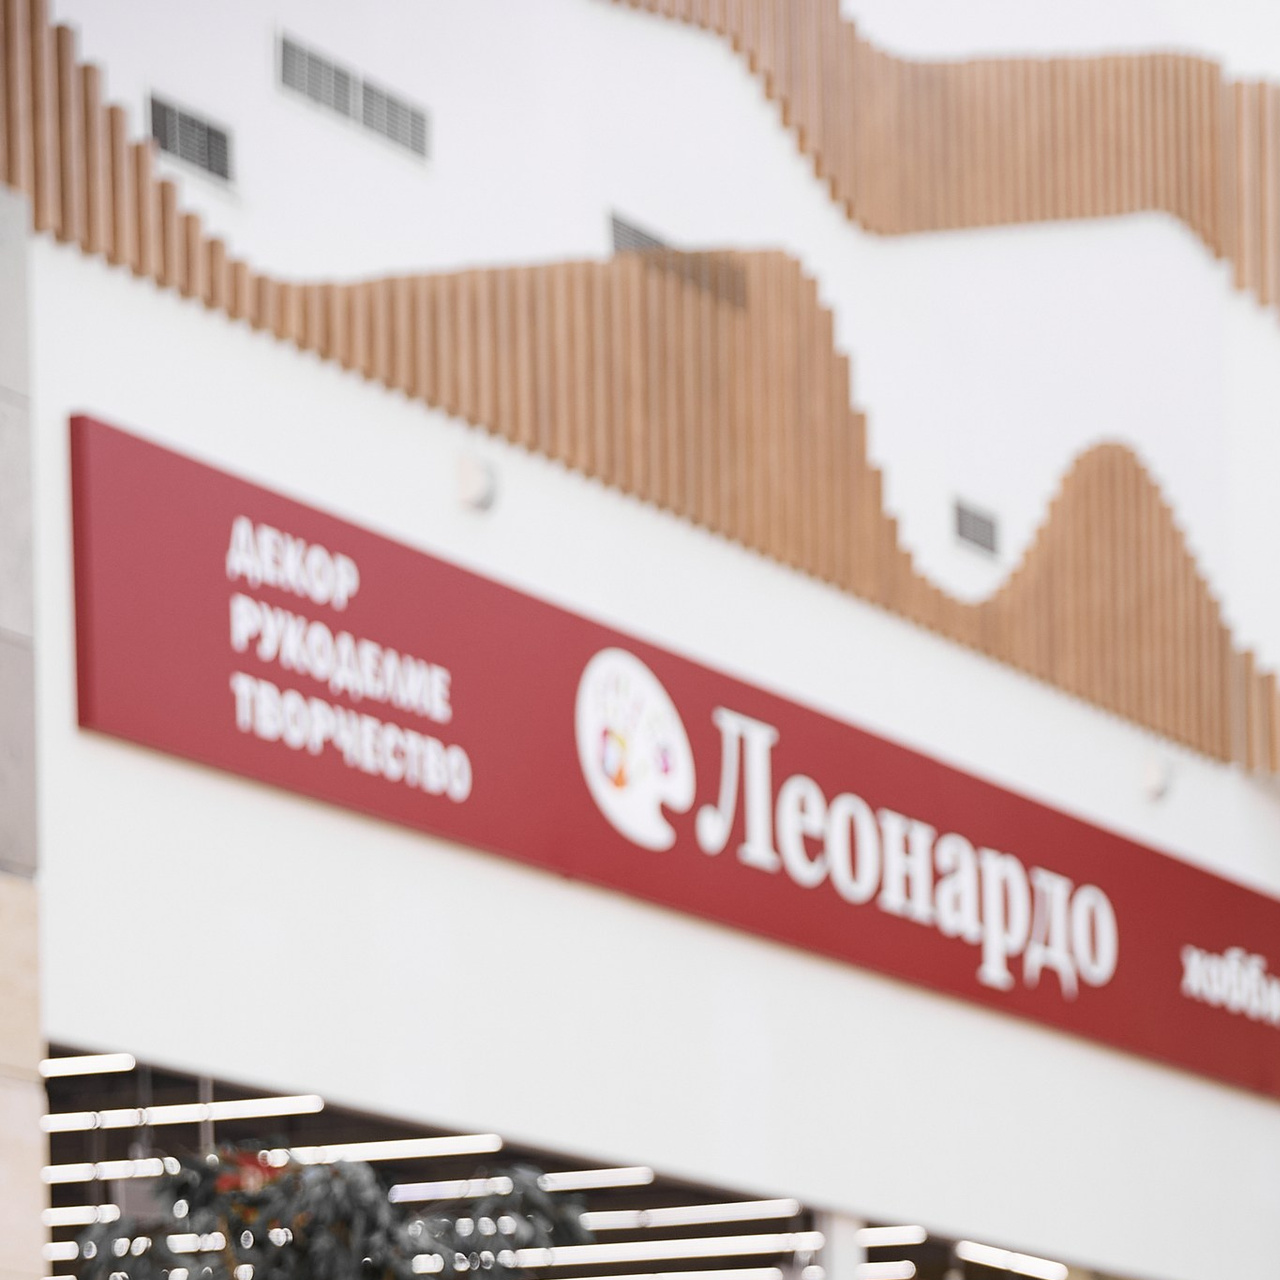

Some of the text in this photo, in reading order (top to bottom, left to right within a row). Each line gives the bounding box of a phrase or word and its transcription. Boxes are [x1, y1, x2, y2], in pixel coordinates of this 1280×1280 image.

[226, 515, 360, 611] ДЕКОР
[230, 593, 453, 724] РУКОДЕЛИЕ
[230, 671, 473, 803] ТВОРЧЕСТВО
[696, 706, 1119, 1001] Леонардо
